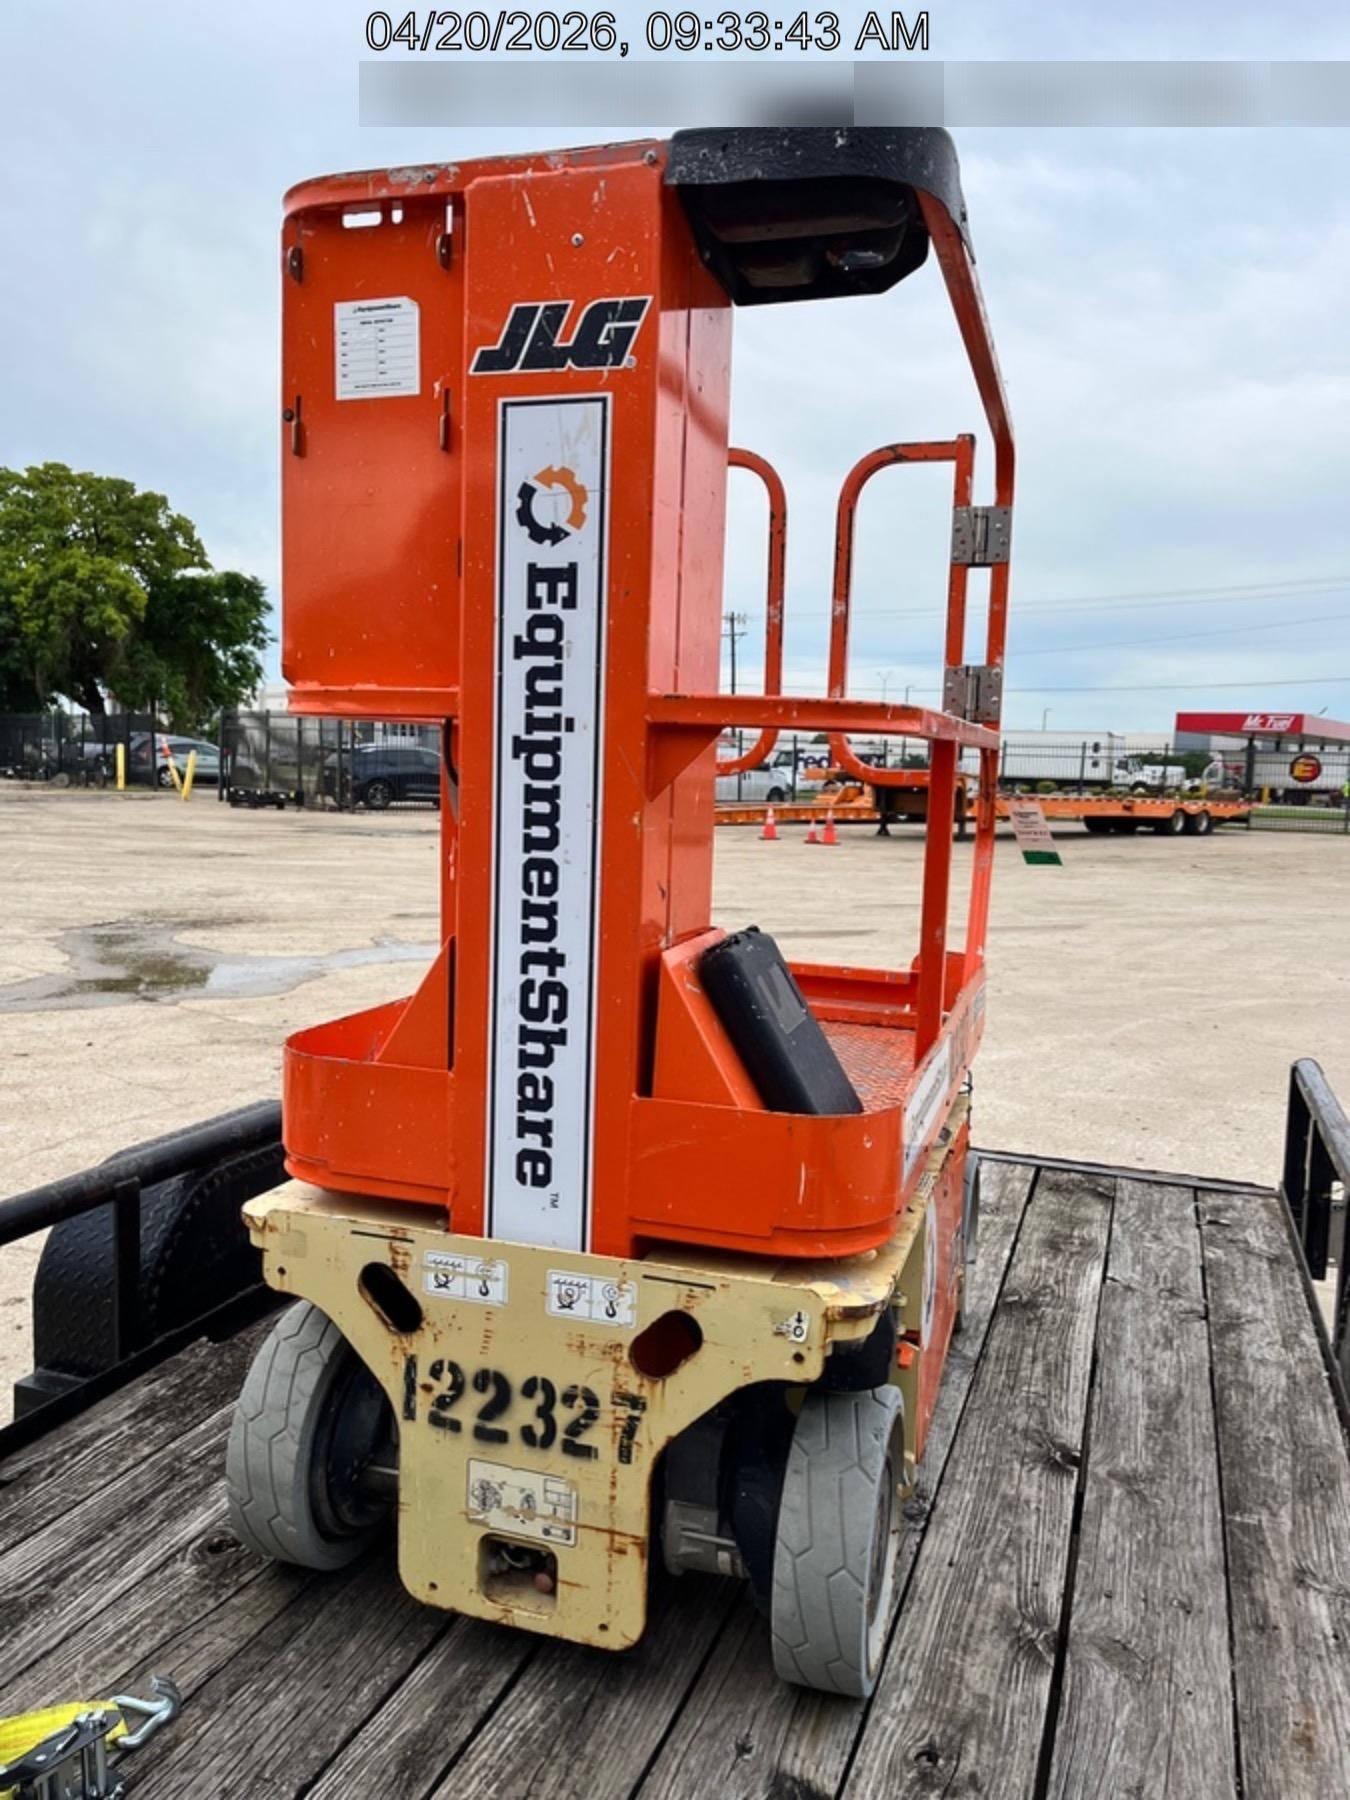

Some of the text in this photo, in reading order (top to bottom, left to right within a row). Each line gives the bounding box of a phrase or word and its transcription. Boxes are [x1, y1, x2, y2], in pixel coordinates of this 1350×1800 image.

[469, 296, 653, 375] JLG
[512, 562, 578, 1189] EquipmentShare
[402, 1354, 648, 1465] 122327
